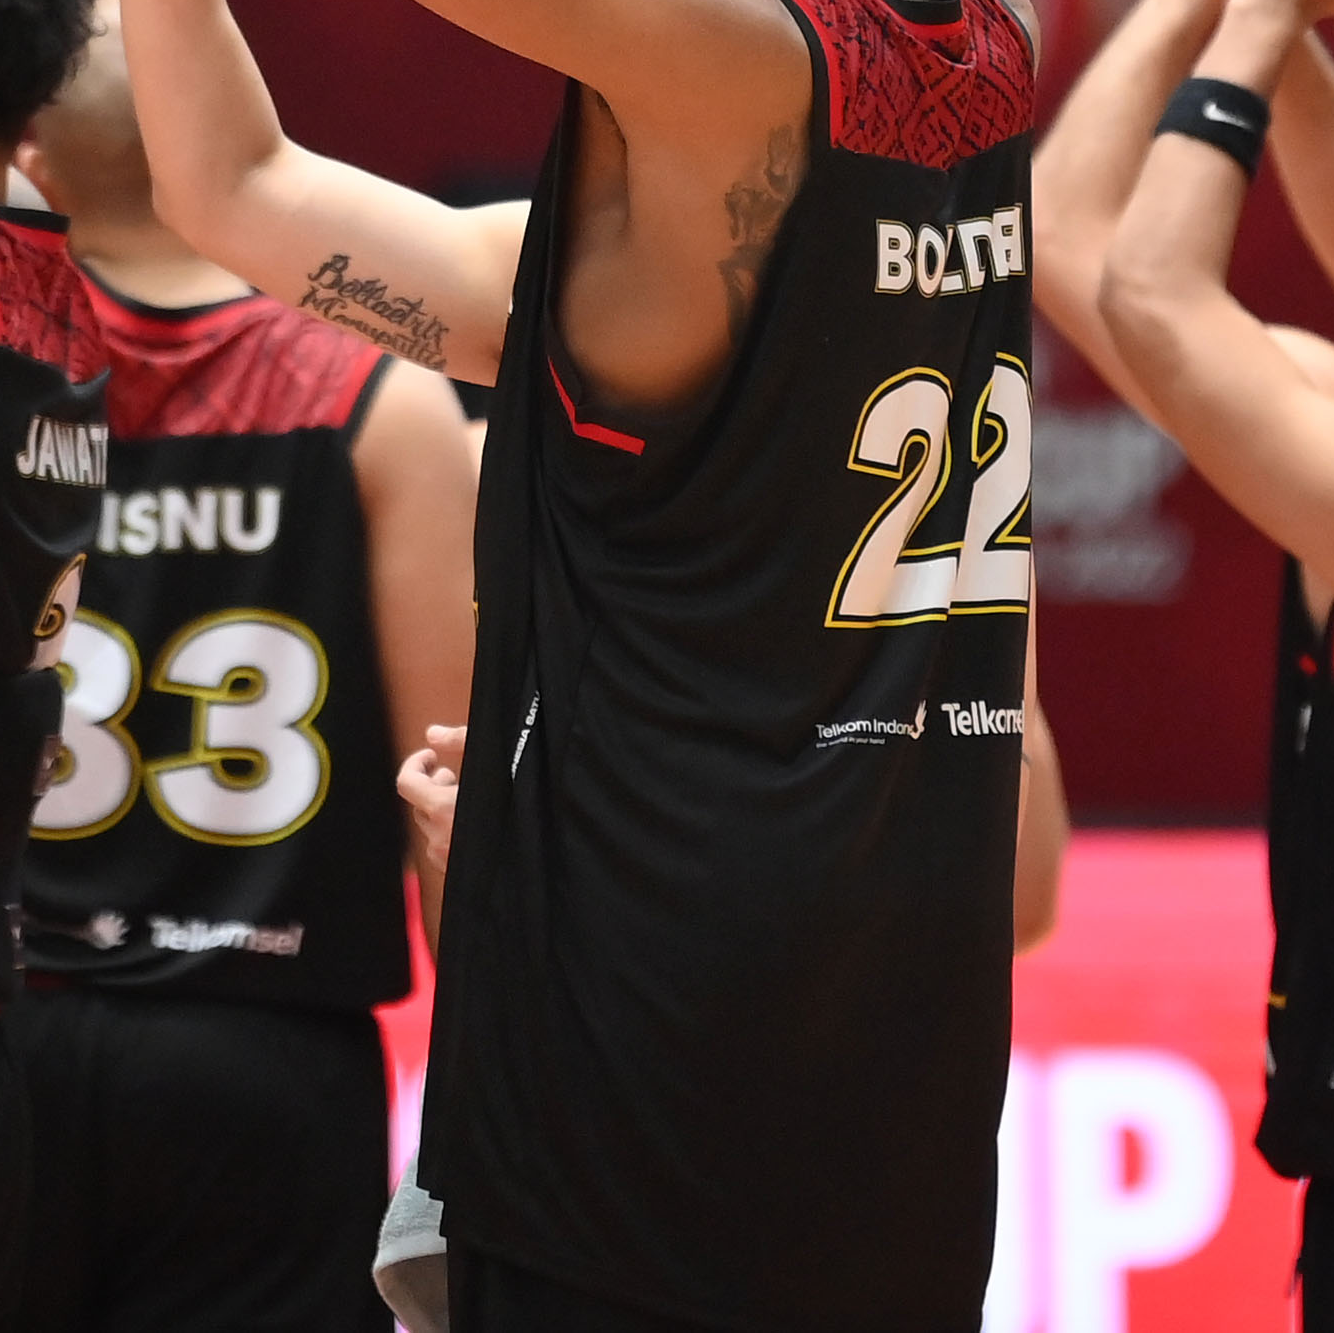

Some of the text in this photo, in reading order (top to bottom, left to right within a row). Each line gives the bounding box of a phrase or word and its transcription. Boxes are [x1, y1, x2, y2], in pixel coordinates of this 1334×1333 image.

[95, 485, 282, 557] ISNU
[825, 352, 1032, 628] 22
[29, 608, 330, 847] 33
